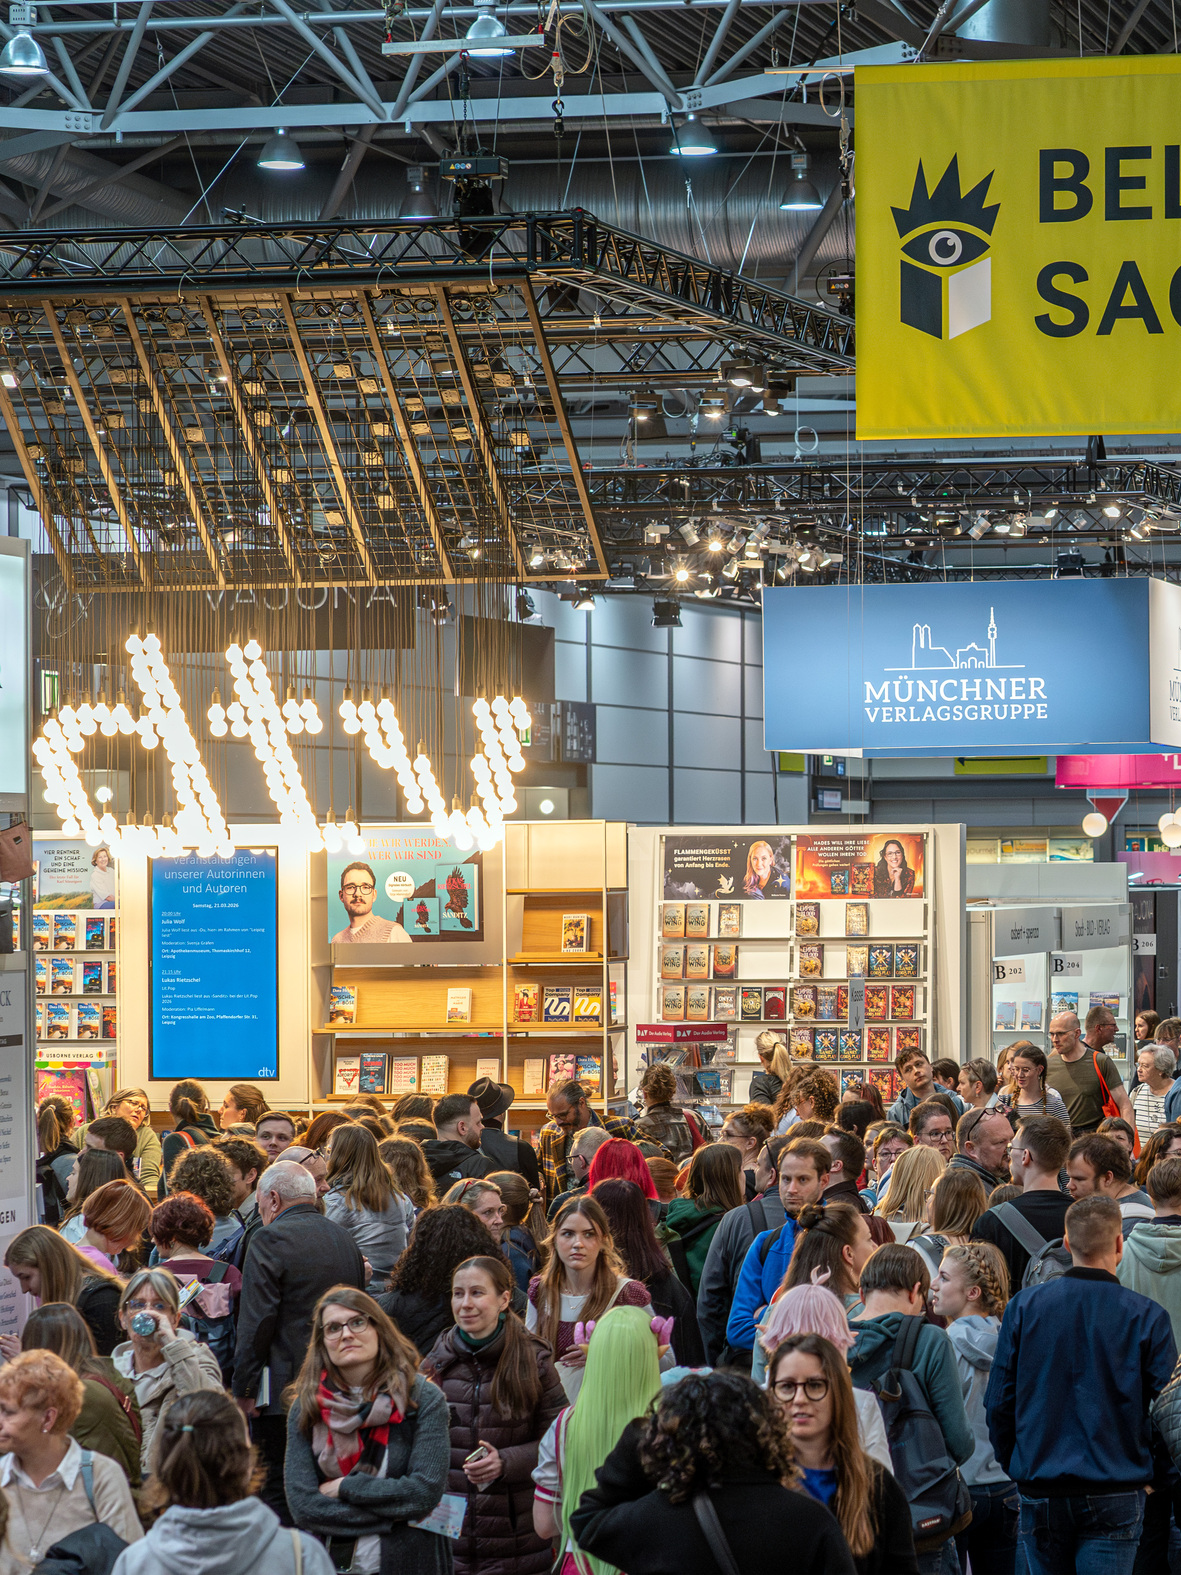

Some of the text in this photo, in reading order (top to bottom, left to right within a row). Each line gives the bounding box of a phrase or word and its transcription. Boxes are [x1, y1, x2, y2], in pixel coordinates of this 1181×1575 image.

[864, 675, 1047, 703] MÜNCHNER
[865, 703, 1048, 723] VERLAGSGRUPPE
[394, 850, 414, 861] WIR
[416, 850, 442, 860] SIND
[164, 869, 265, 879] unserer Autorinnen
[182, 883, 247, 894] und Autoren
[1053, 958, 1065, 972] B
[995, 965, 1007, 979] B
[258, 1067, 275, 1077] dtv
